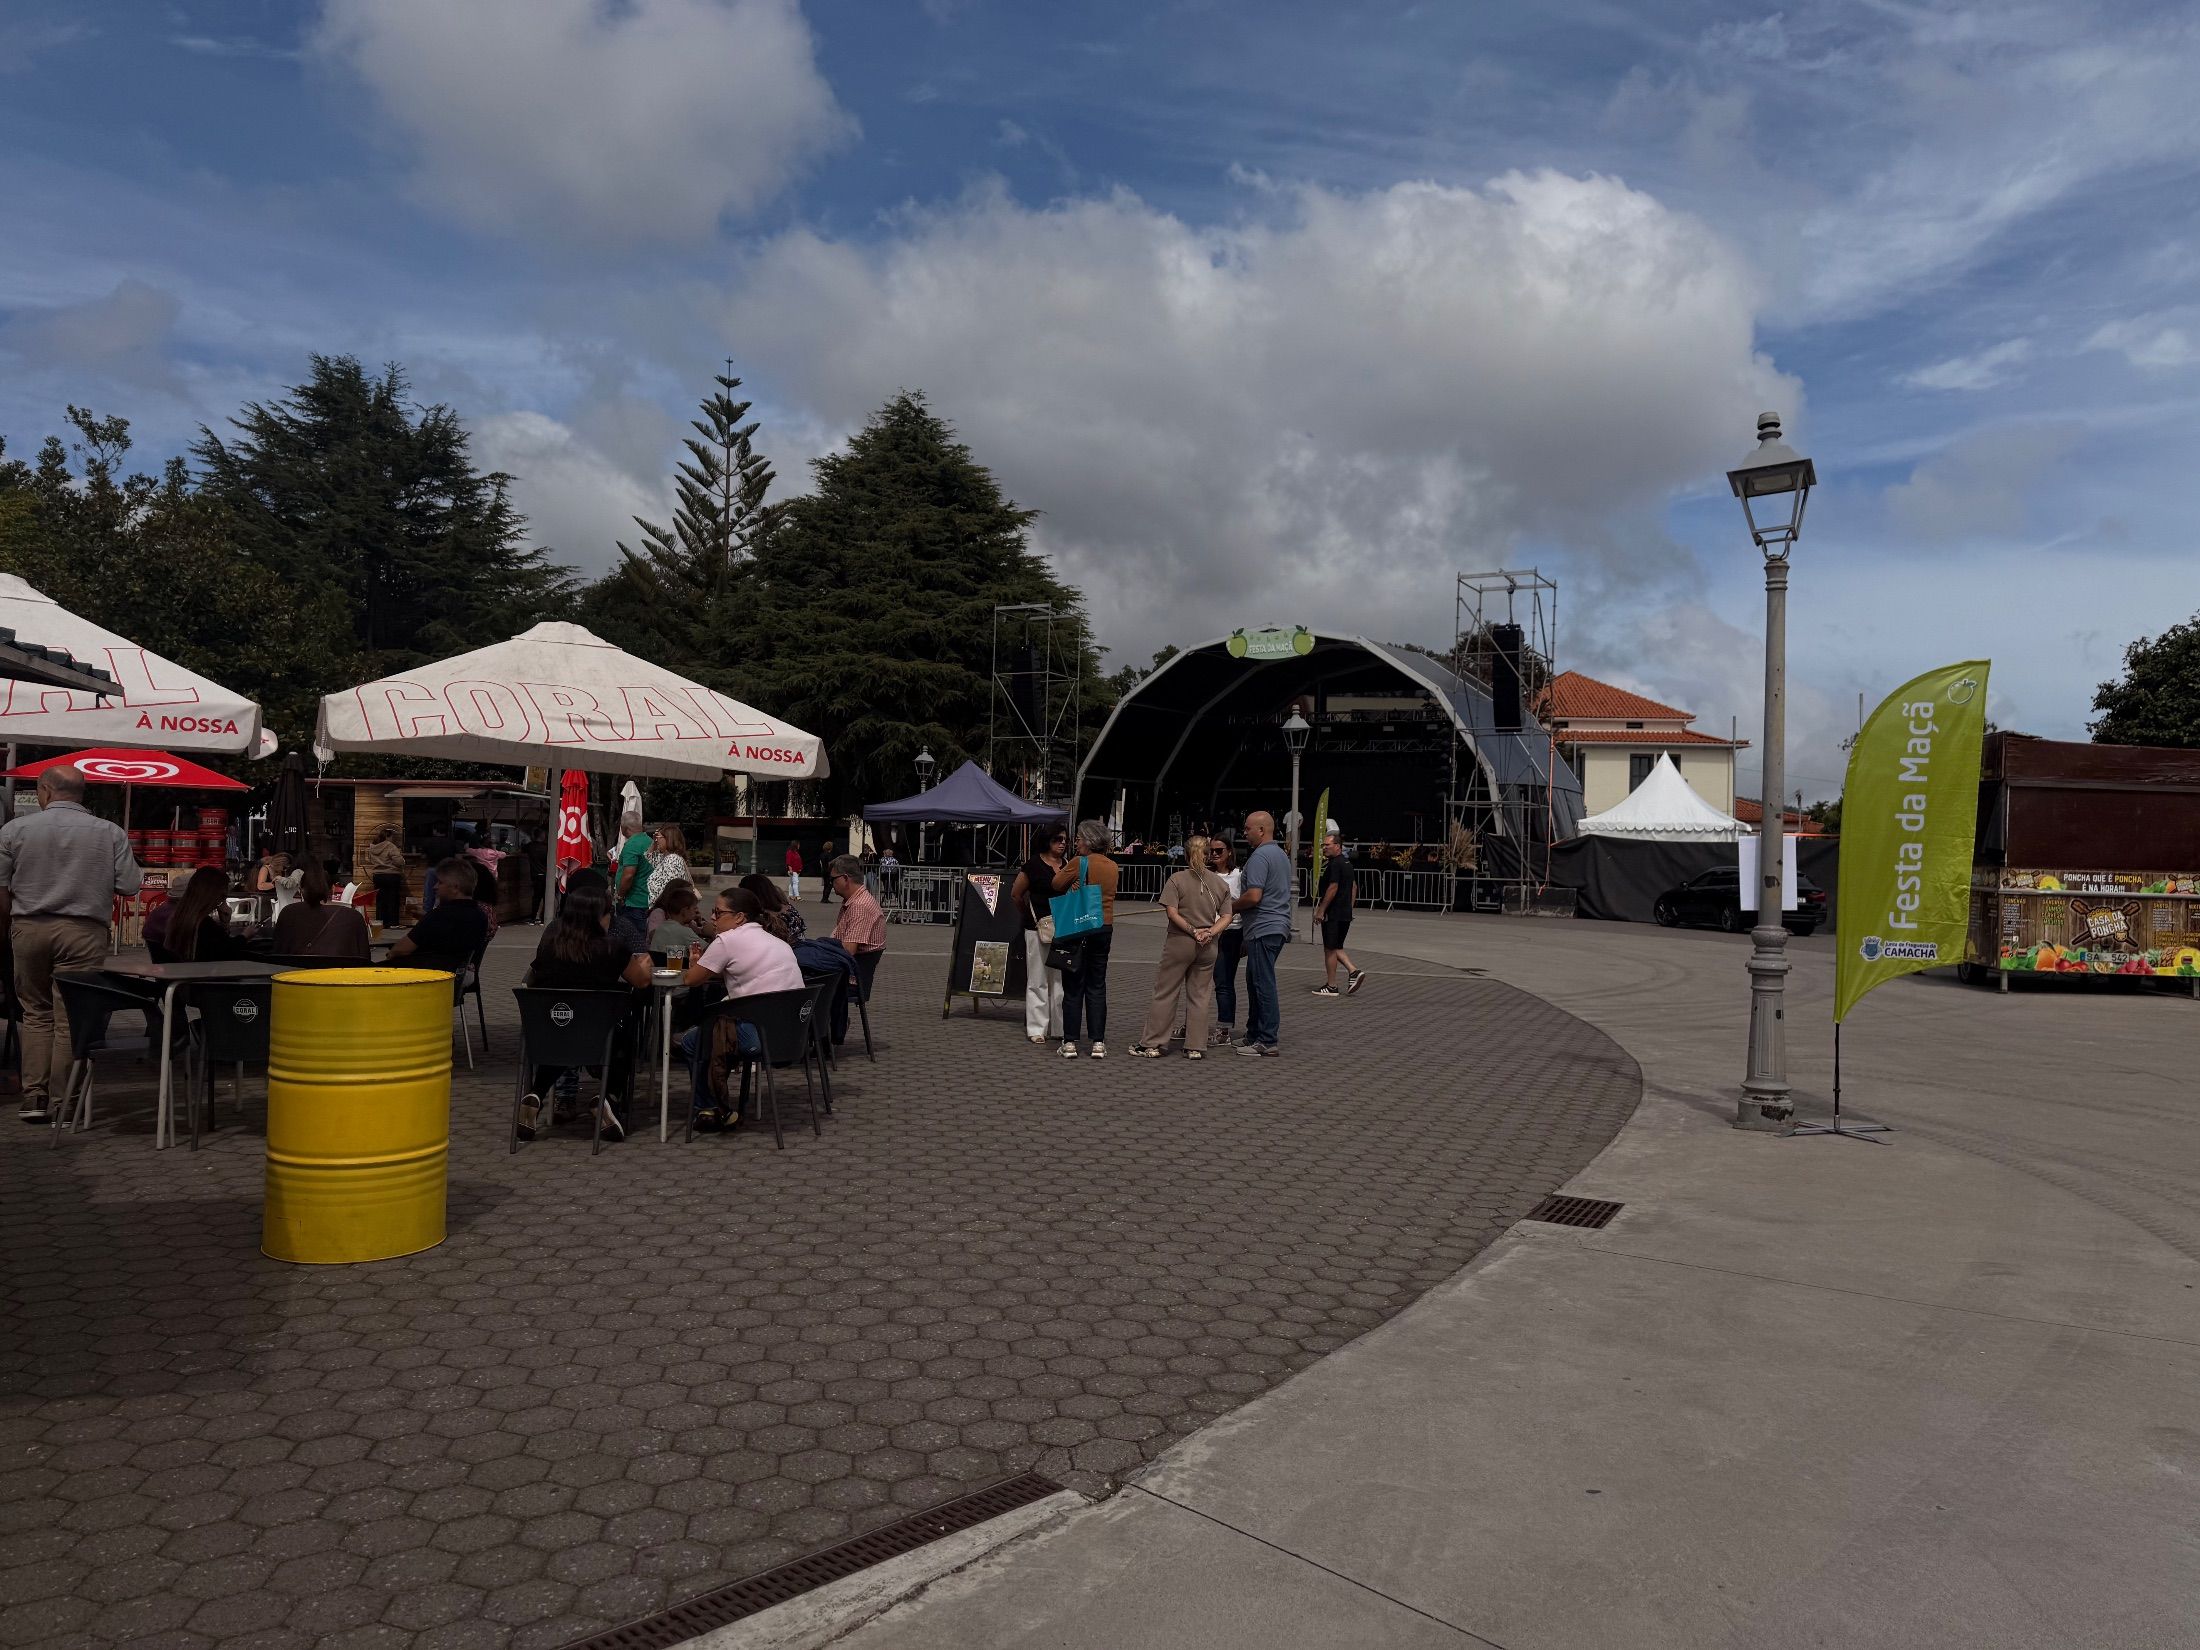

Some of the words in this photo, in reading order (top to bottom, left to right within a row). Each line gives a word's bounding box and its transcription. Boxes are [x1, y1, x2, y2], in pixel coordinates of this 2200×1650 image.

[355, 681, 775, 743] CORAL
[136, 711, 153, 730] À
[161, 715, 239, 735] NOSSA
[1898, 702, 1939, 782] Maçã
[728, 741, 741, 757] À
[747, 745, 805, 764] NOSSA
[1894, 794, 1927, 832] da
[1889, 843, 1924, 929] Festa
[2063, 873, 2091, 882] PONCHA
[2108, 874, 2113, 882] É
[2088, 884, 2099, 892] NA
[2087, 915, 2110, 927] CASA
[2112, 911, 2126, 923] DA
[2091, 921, 2128, 938] PONCHA
[1885, 948, 1936, 958] CAMACHA
[2111, 953, 2128, 961] 542
